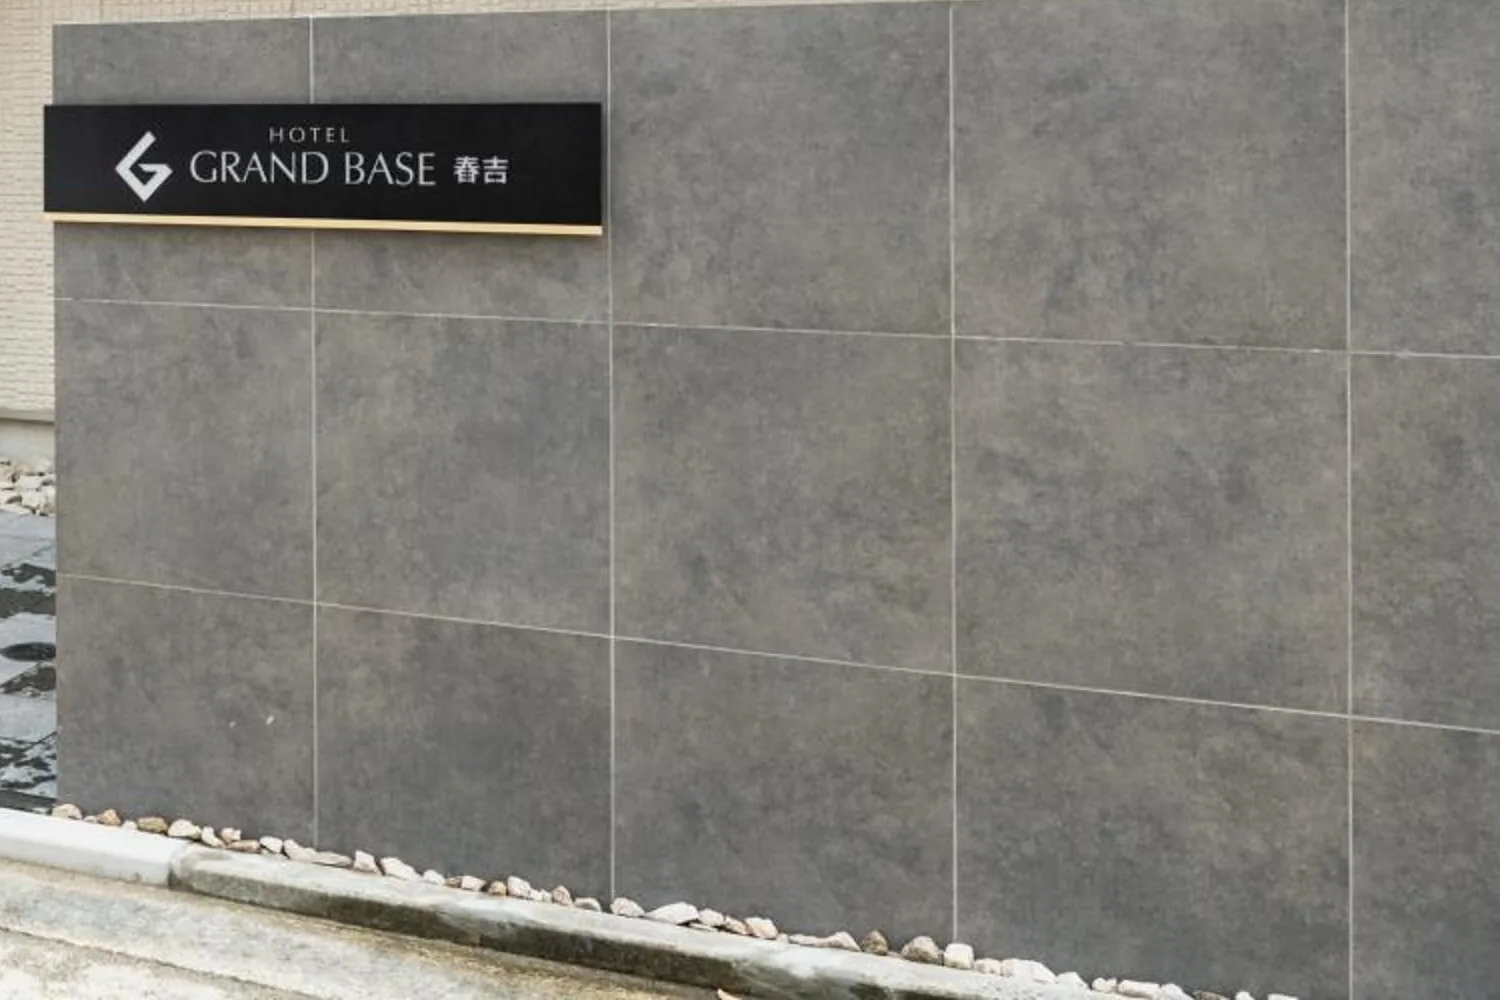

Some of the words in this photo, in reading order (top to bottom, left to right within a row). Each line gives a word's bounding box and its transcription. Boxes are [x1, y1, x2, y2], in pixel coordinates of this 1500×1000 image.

[269, 127, 350, 143] HOTEL
[189, 150, 329, 185] GRAND
[344, 151, 436, 187] BASE
[452, 155, 509, 185] 春吉
